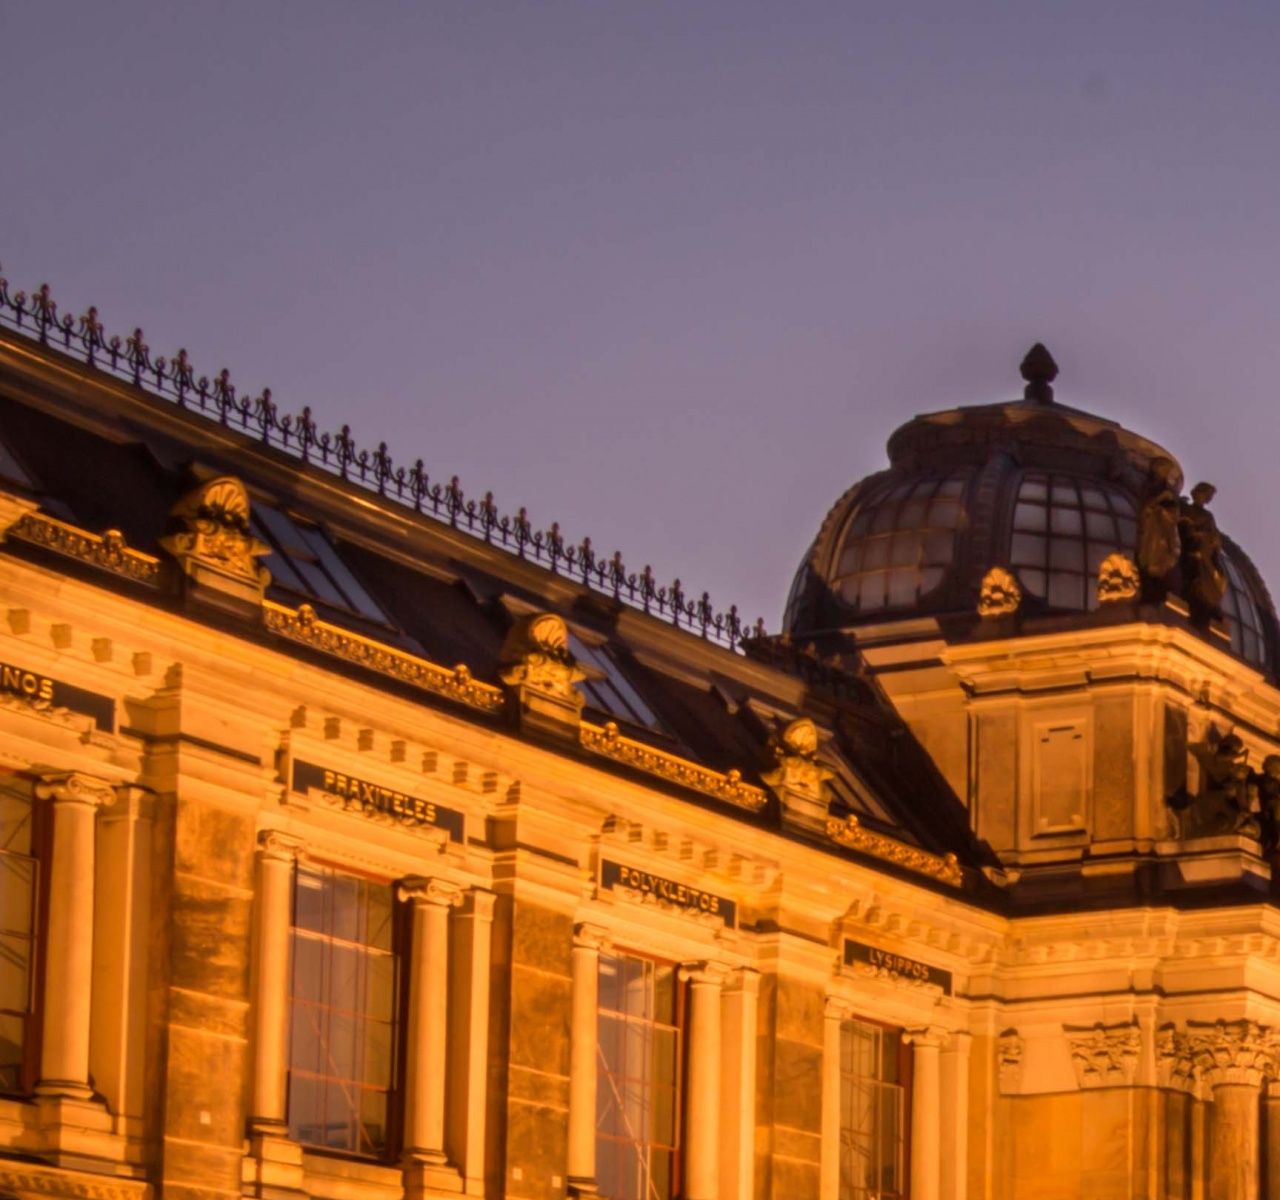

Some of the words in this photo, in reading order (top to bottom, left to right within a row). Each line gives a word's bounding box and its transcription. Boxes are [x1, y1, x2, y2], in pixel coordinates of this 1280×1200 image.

[323, 769, 438, 824] PRAXITELES
[619, 866, 720, 914] POLYKLEITOS
[867, 948, 930, 980] LYSIPPOS
